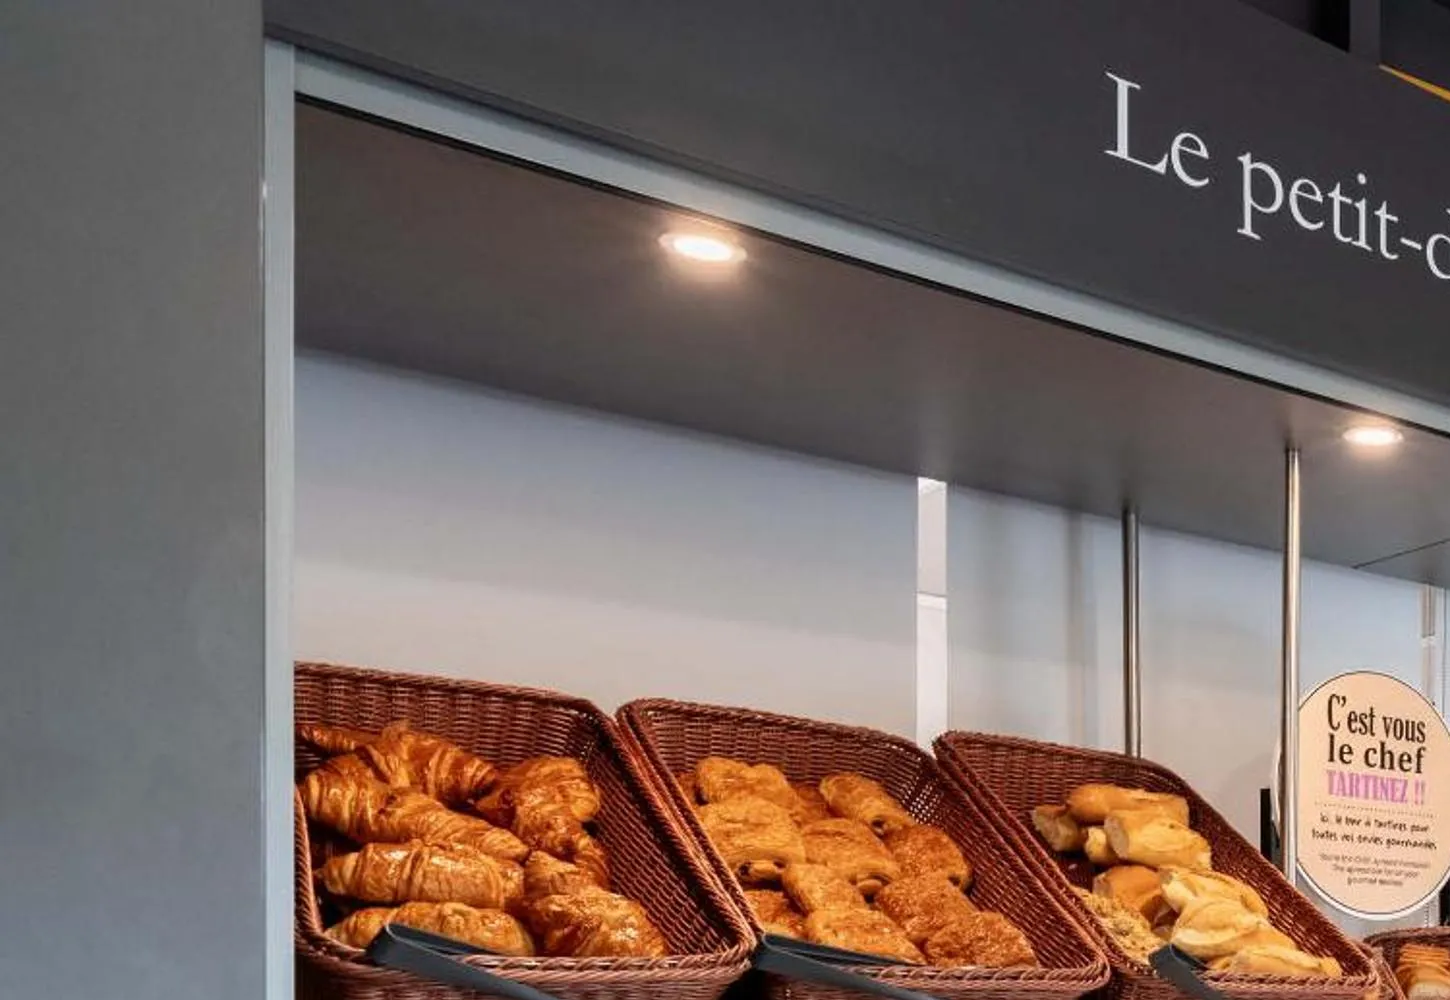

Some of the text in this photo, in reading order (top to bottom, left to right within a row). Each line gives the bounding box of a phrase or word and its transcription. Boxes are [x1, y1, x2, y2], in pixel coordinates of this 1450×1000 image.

[1104, 72, 1210, 188] Le
[1327, 693, 1426, 744] C'est vous
[1327, 734, 1426, 774] le chef
[1327, 770, 1408, 804] TARTINEZ
